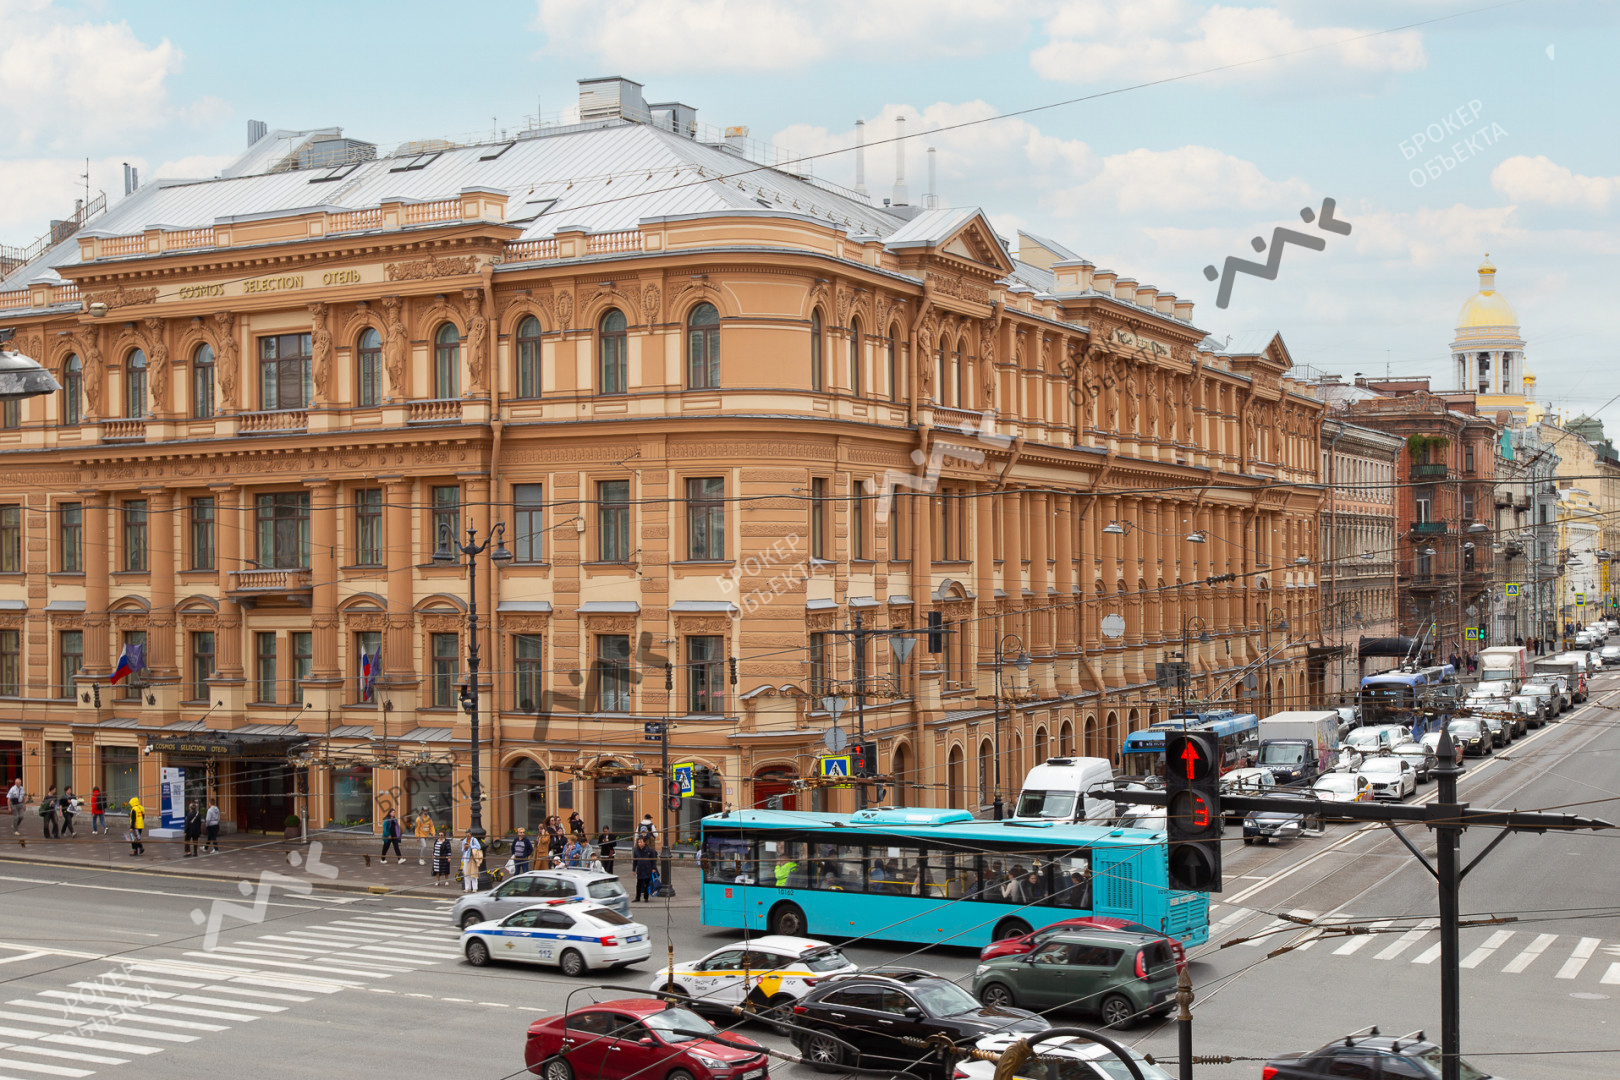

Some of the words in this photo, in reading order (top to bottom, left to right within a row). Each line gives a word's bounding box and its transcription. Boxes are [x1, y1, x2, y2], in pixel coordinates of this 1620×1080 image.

[179, 284, 224, 299] COSMOS
[243, 275, 303, 293] SELECTION
[322, 269, 361, 285] ОТЕЛЬ
[180, 744, 206, 752] SELECTION
[1194, 798, 1209, 826] 3
[778, 888, 795, 896] 10162
[538, 949, 553, 959] 112
